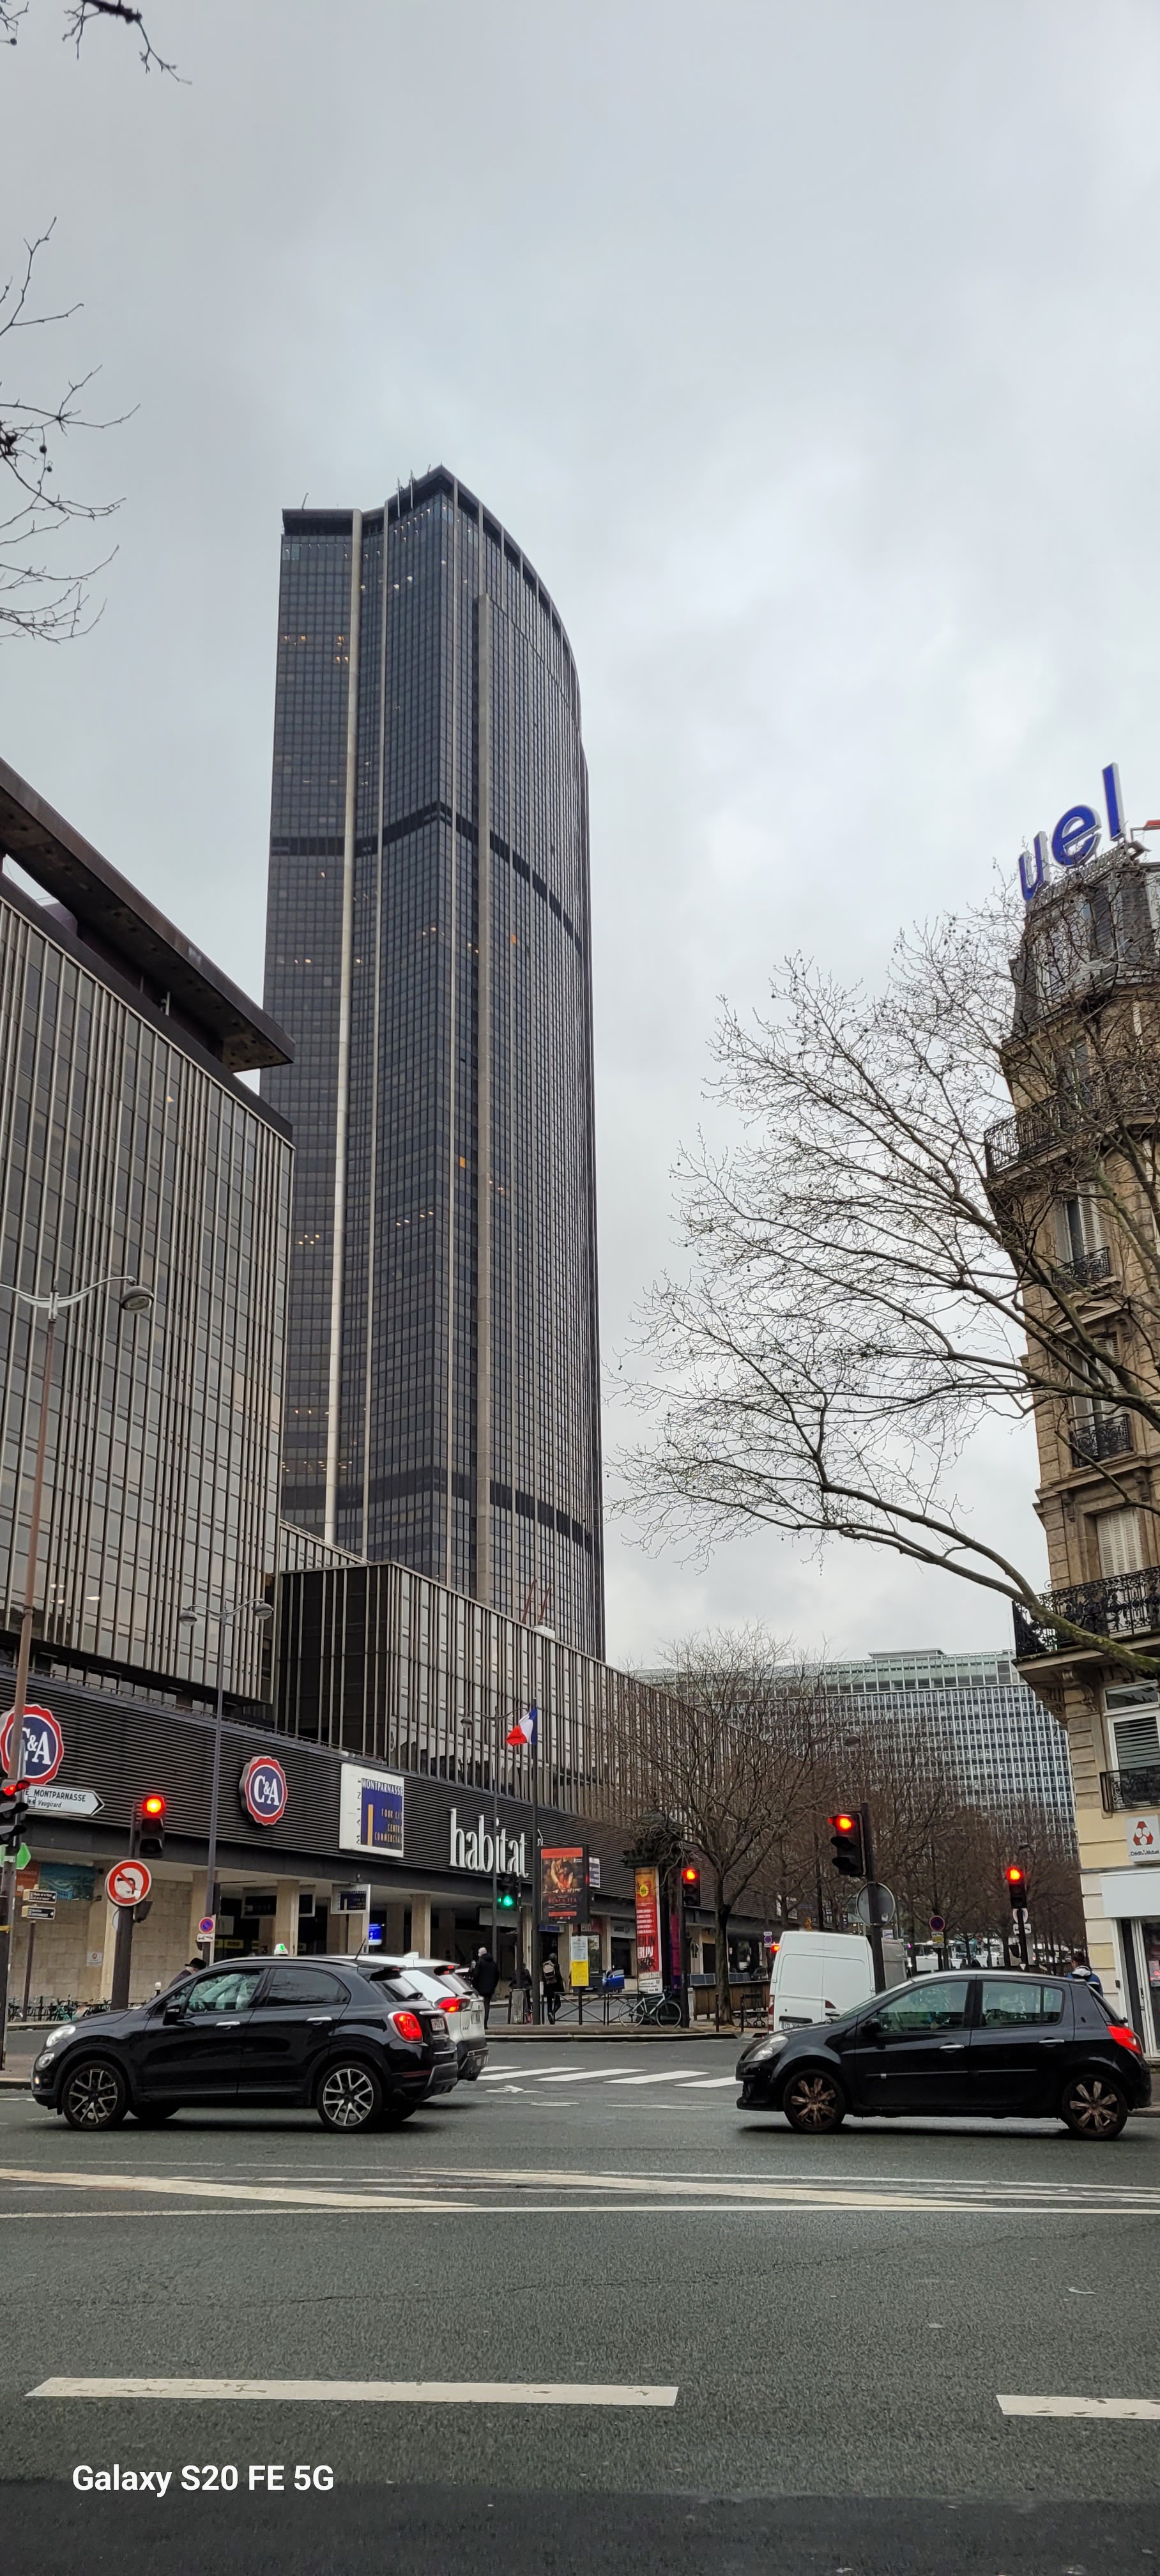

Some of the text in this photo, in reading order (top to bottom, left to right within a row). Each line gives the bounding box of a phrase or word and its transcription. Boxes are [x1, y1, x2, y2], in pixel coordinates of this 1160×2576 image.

[34, 1789, 86, 1802] MONTPARNASSE
[254, 1775, 280, 1806] C&A
[362, 1779, 403, 1797] MONTPARNASSE
[38, 1800, 62, 1808] Vaugirard
[381, 1808, 393, 1819] TOUR
[449, 1808, 530, 1878] habitat
